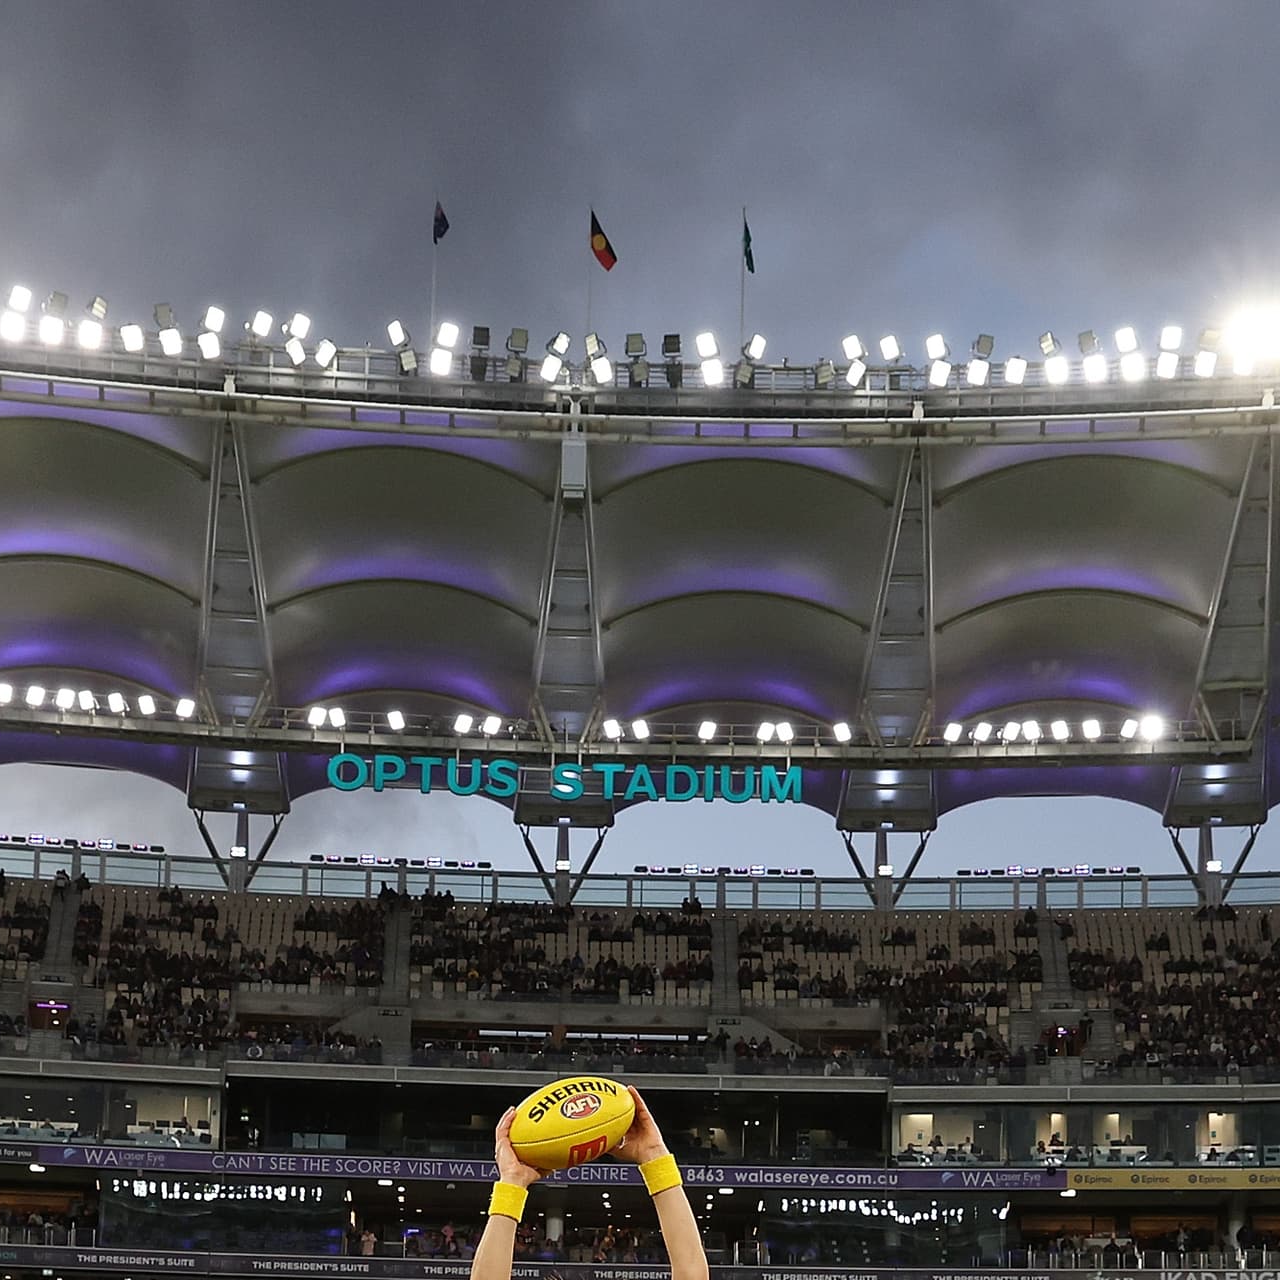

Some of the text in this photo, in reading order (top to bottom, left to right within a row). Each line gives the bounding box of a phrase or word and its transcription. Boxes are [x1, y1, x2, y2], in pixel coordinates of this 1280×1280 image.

[326, 753, 803, 803] OPTUS STADIUM
[528, 1081, 617, 1123] SHERRIN
[566, 1097, 600, 1118] AFL
[16, 1150, 32, 1159] you
[84, 1149, 119, 1166] WA
[120, 1152, 145, 1162] Laser
[147, 1152, 165, 1163] Eye
[212, 1155, 265, 1170] CAN'T
[270, 1156, 297, 1171] SEE
[302, 1157, 329, 1173] THE
[335, 1158, 401, 1175] SCORE?
[407, 1161, 442, 1177] VISIT
[448, 1162, 476, 1178] WA
[567, 1166, 629, 1181] CENTRE
[687, 1168, 898, 1187] 8463 walasereye.com.au
[961, 1171, 995, 1187] WA
[996, 1172, 1021, 1182] Laser
[1023, 1173, 1041, 1184] Eye
[77, 1254, 195, 1268] THE PRESIDENT'S SUITE
[252, 1260, 370, 1273] THE PRESIDENT'S SUITE
[423, 1266, 443, 1275] THE
[511, 1268, 540, 1278] SUITE
[594, 1270, 671, 1280] THE PRESIDENT'
